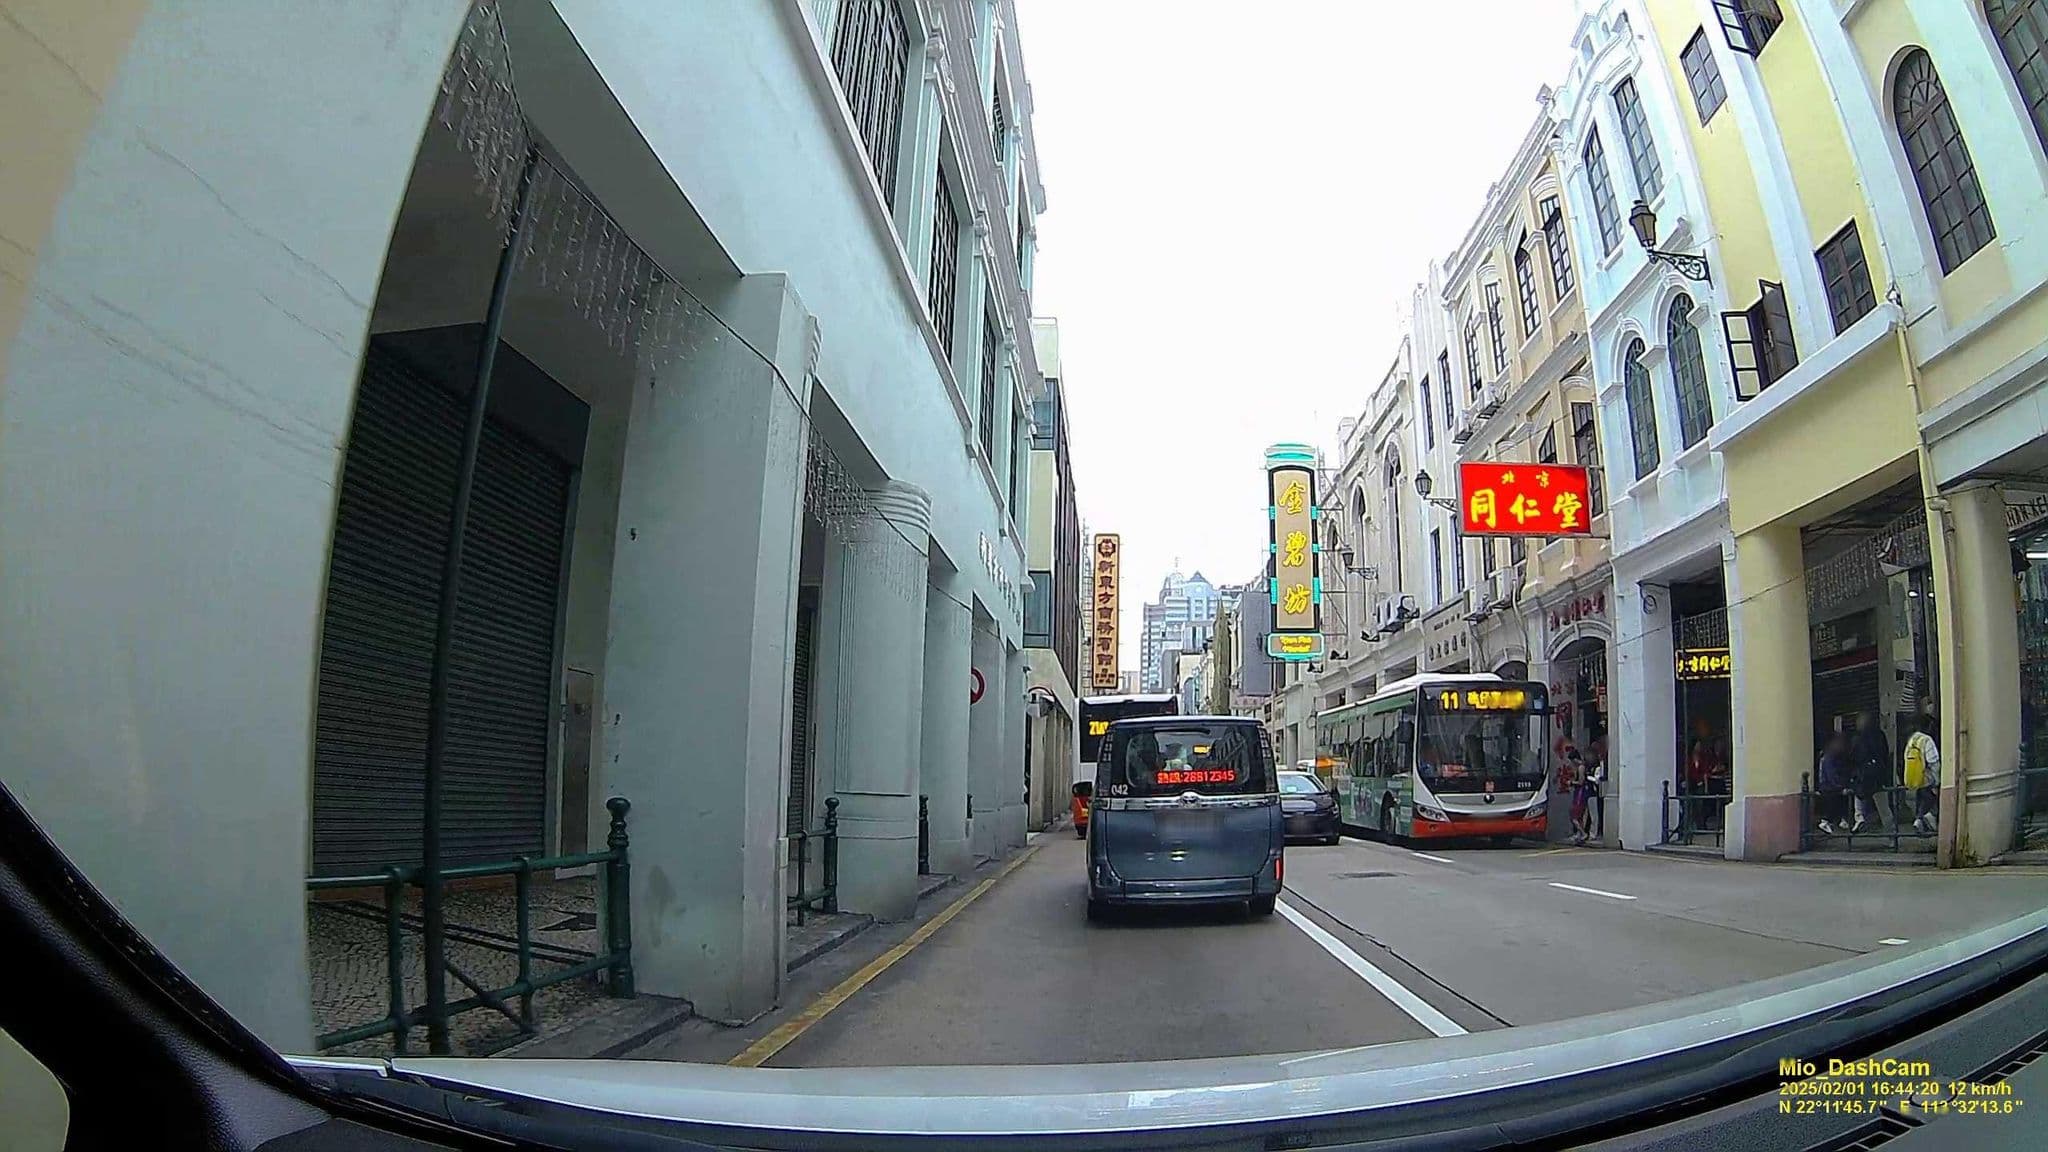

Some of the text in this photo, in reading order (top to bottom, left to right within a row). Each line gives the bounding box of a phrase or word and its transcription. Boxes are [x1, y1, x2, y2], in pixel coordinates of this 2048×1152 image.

[1501, 470, 1550, 488] 北京
[1470, 488, 1583, 529] 同仁堂
[1279, 481, 1310, 615] 金碧坊
[1440, 691, 1460, 710] 11
